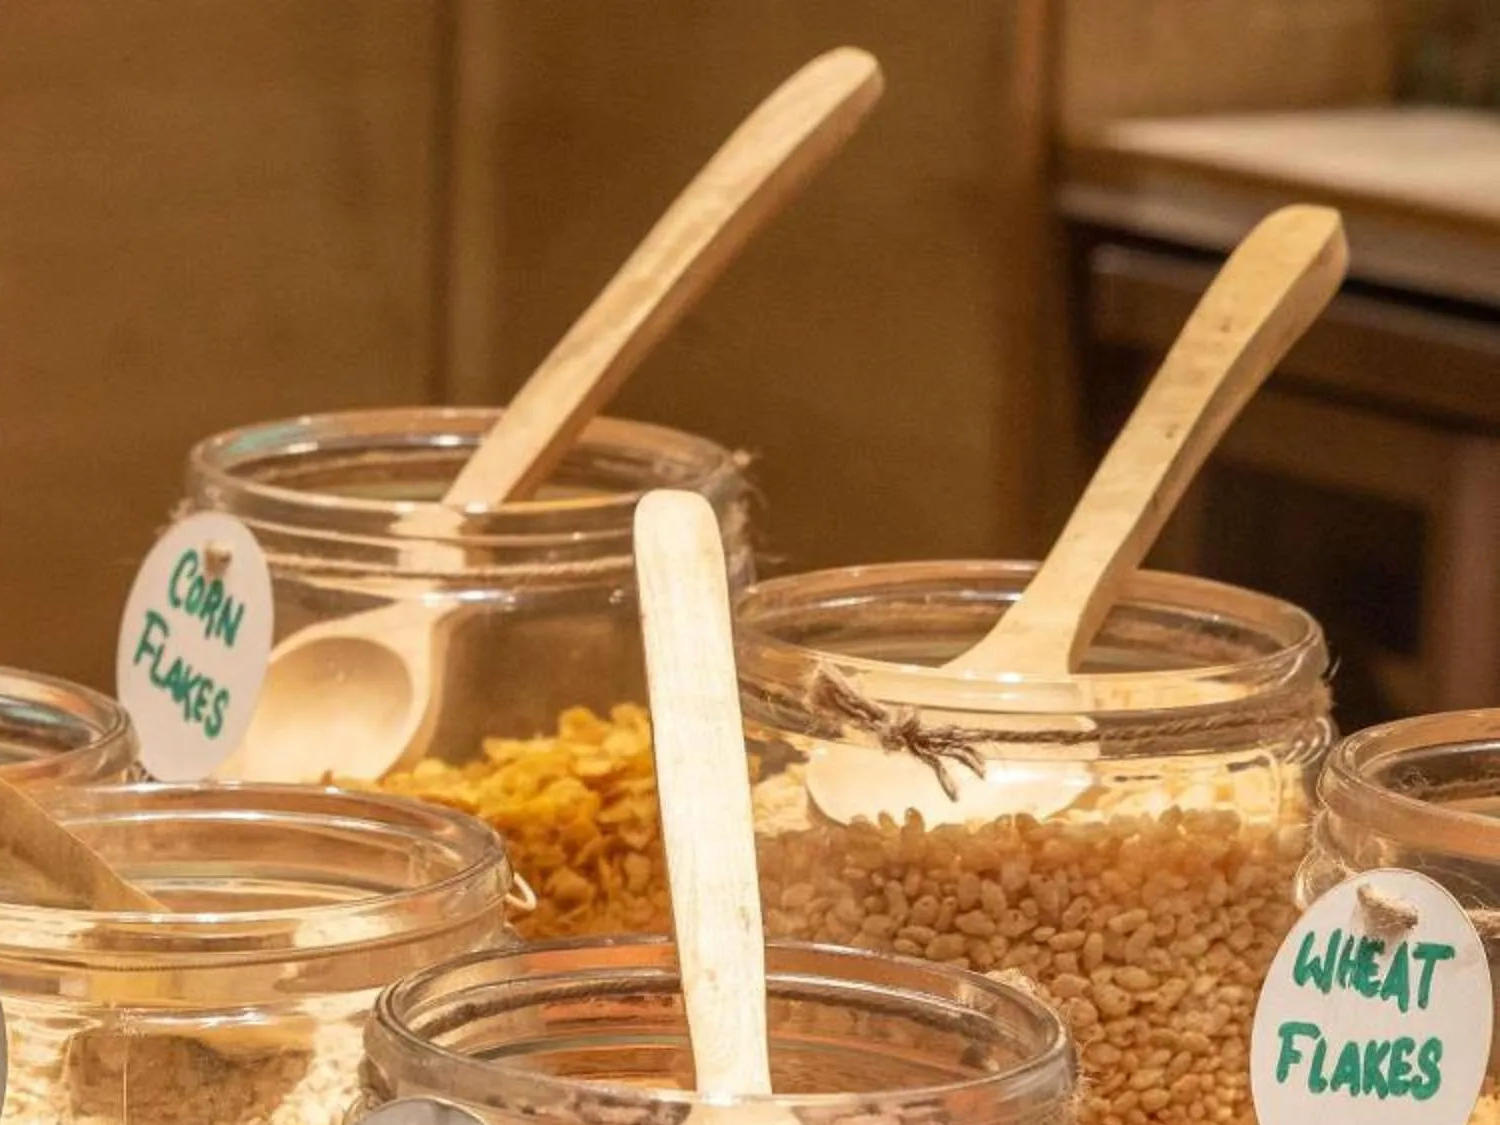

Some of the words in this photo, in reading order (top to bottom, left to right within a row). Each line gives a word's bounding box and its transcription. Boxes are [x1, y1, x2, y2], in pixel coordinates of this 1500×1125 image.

[168, 548, 245, 648] CORN
[133, 609, 231, 740] FLAKES
[1292, 928, 1456, 1013] WHEAT
[1275, 1020, 1444, 1101] FLAKES
